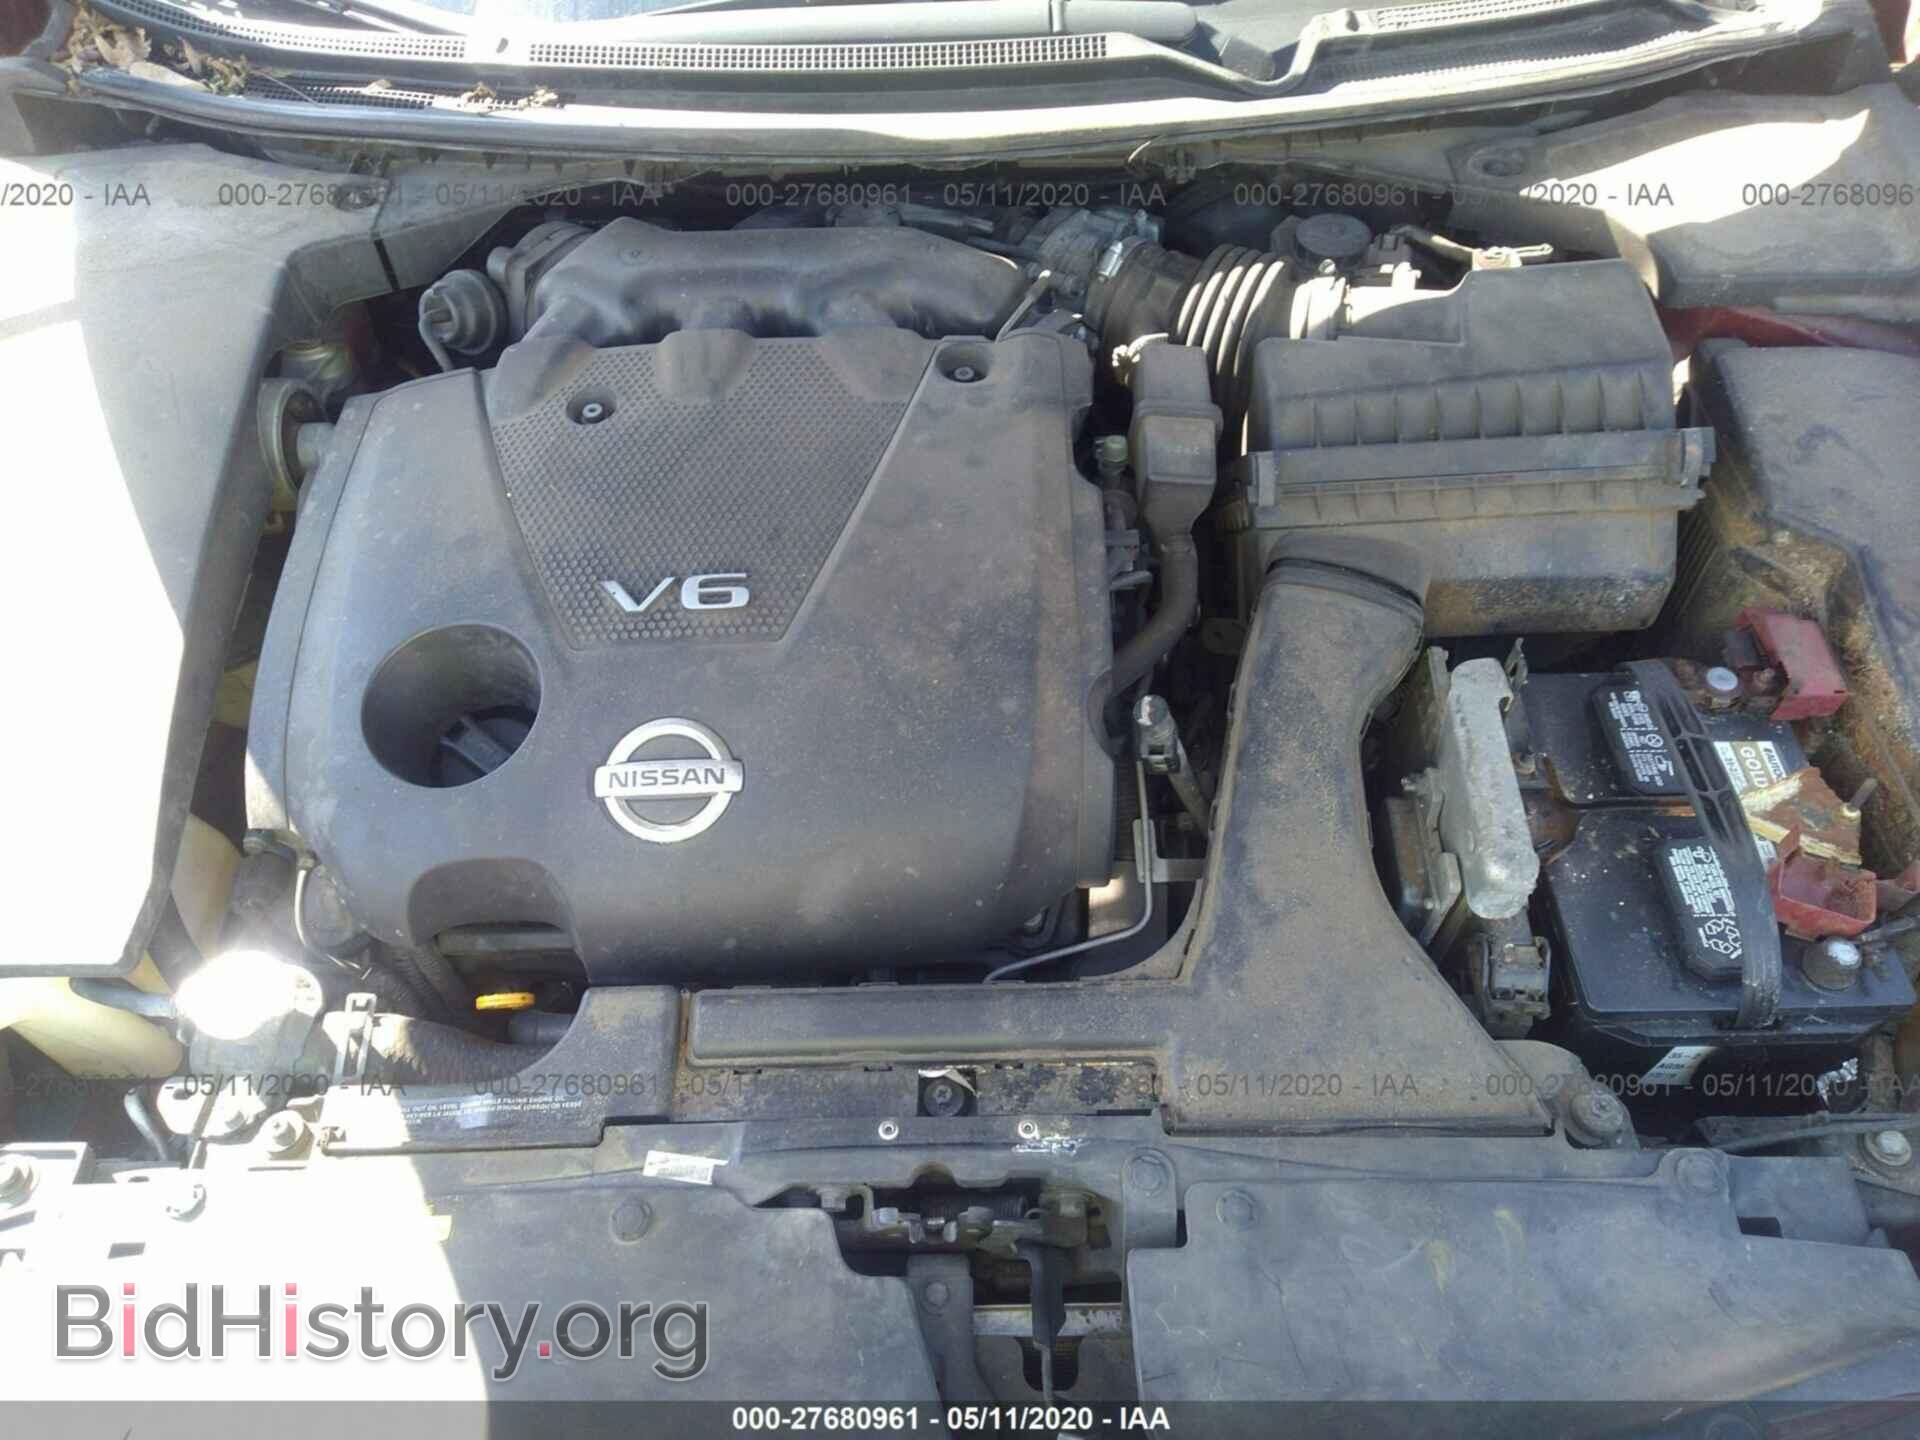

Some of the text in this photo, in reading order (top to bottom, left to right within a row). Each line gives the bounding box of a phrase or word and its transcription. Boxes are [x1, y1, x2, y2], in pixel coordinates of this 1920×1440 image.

[601, 573, 750, 612] V6
[608, 767, 725, 789] NISSAN
[1740, 746, 1769, 788] GOLD
